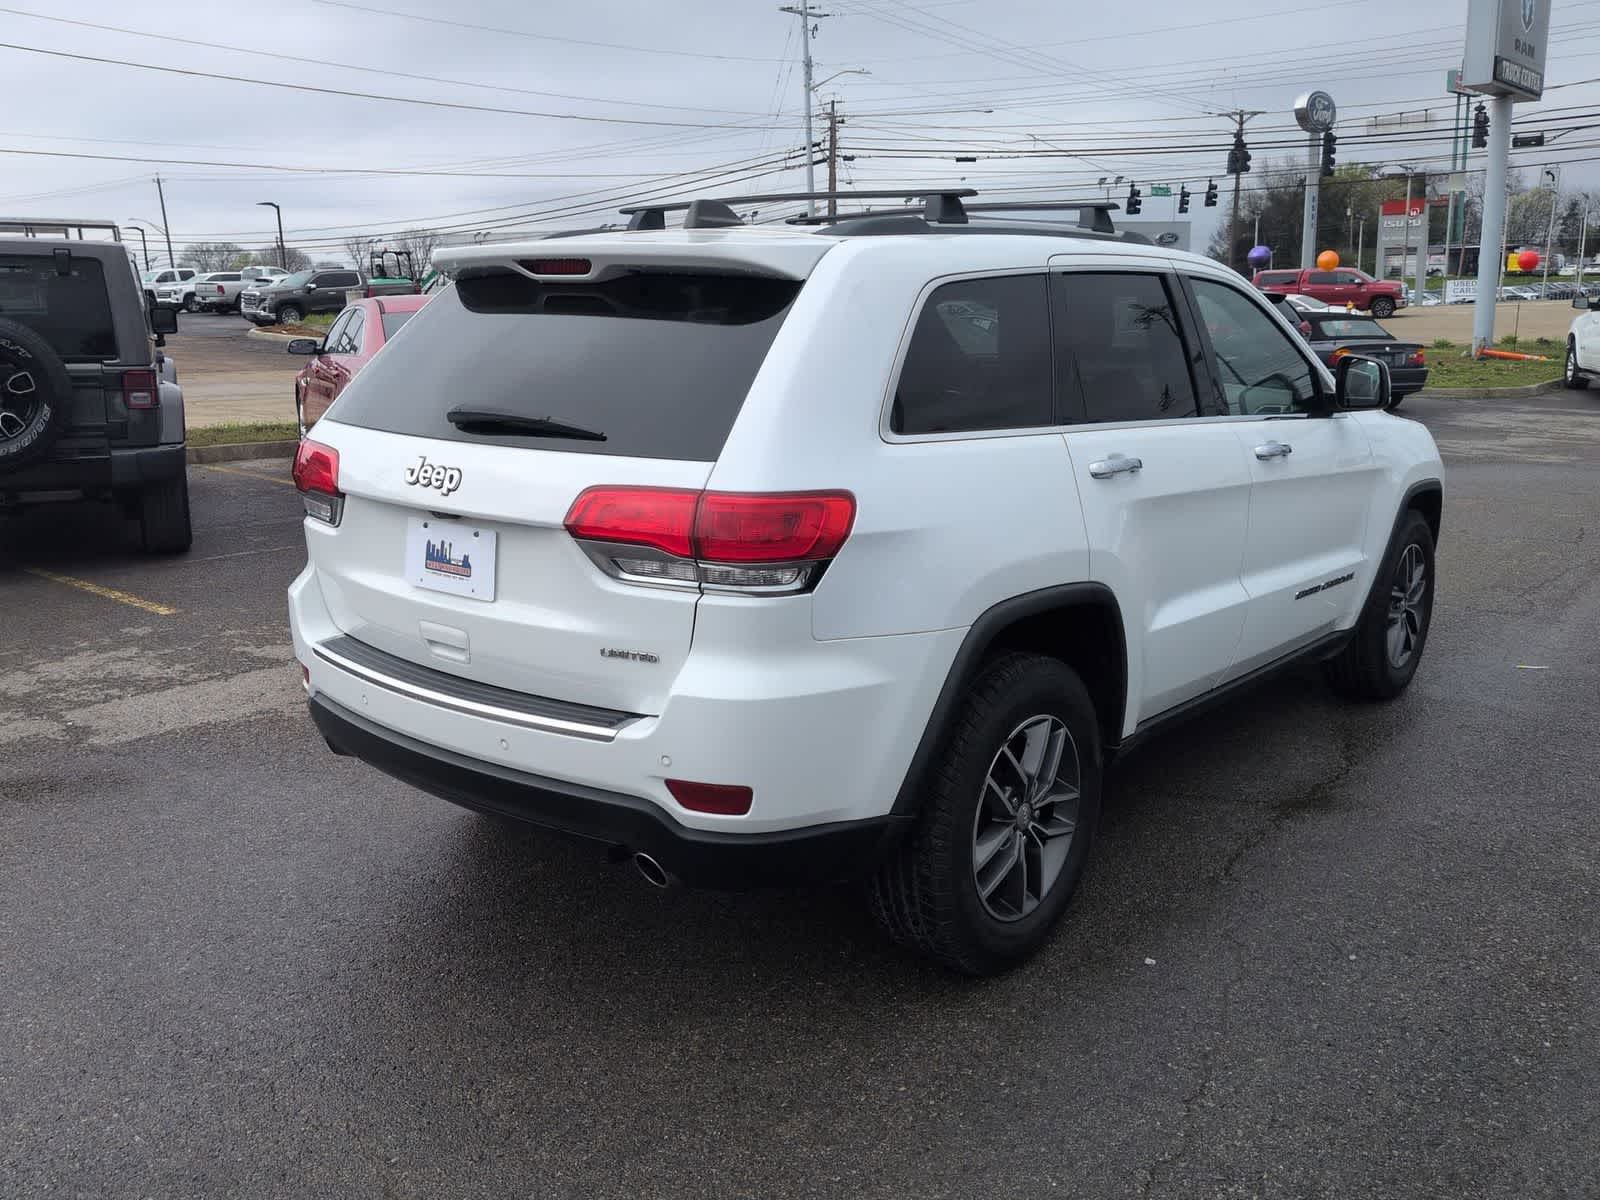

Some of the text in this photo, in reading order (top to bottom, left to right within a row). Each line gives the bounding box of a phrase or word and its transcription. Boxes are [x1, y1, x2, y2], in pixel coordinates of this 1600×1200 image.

[1514, 39, 1535, 57] RAM
[1502, 61, 1520, 83] TRUCK
[405, 456, 463, 496] Jeep
